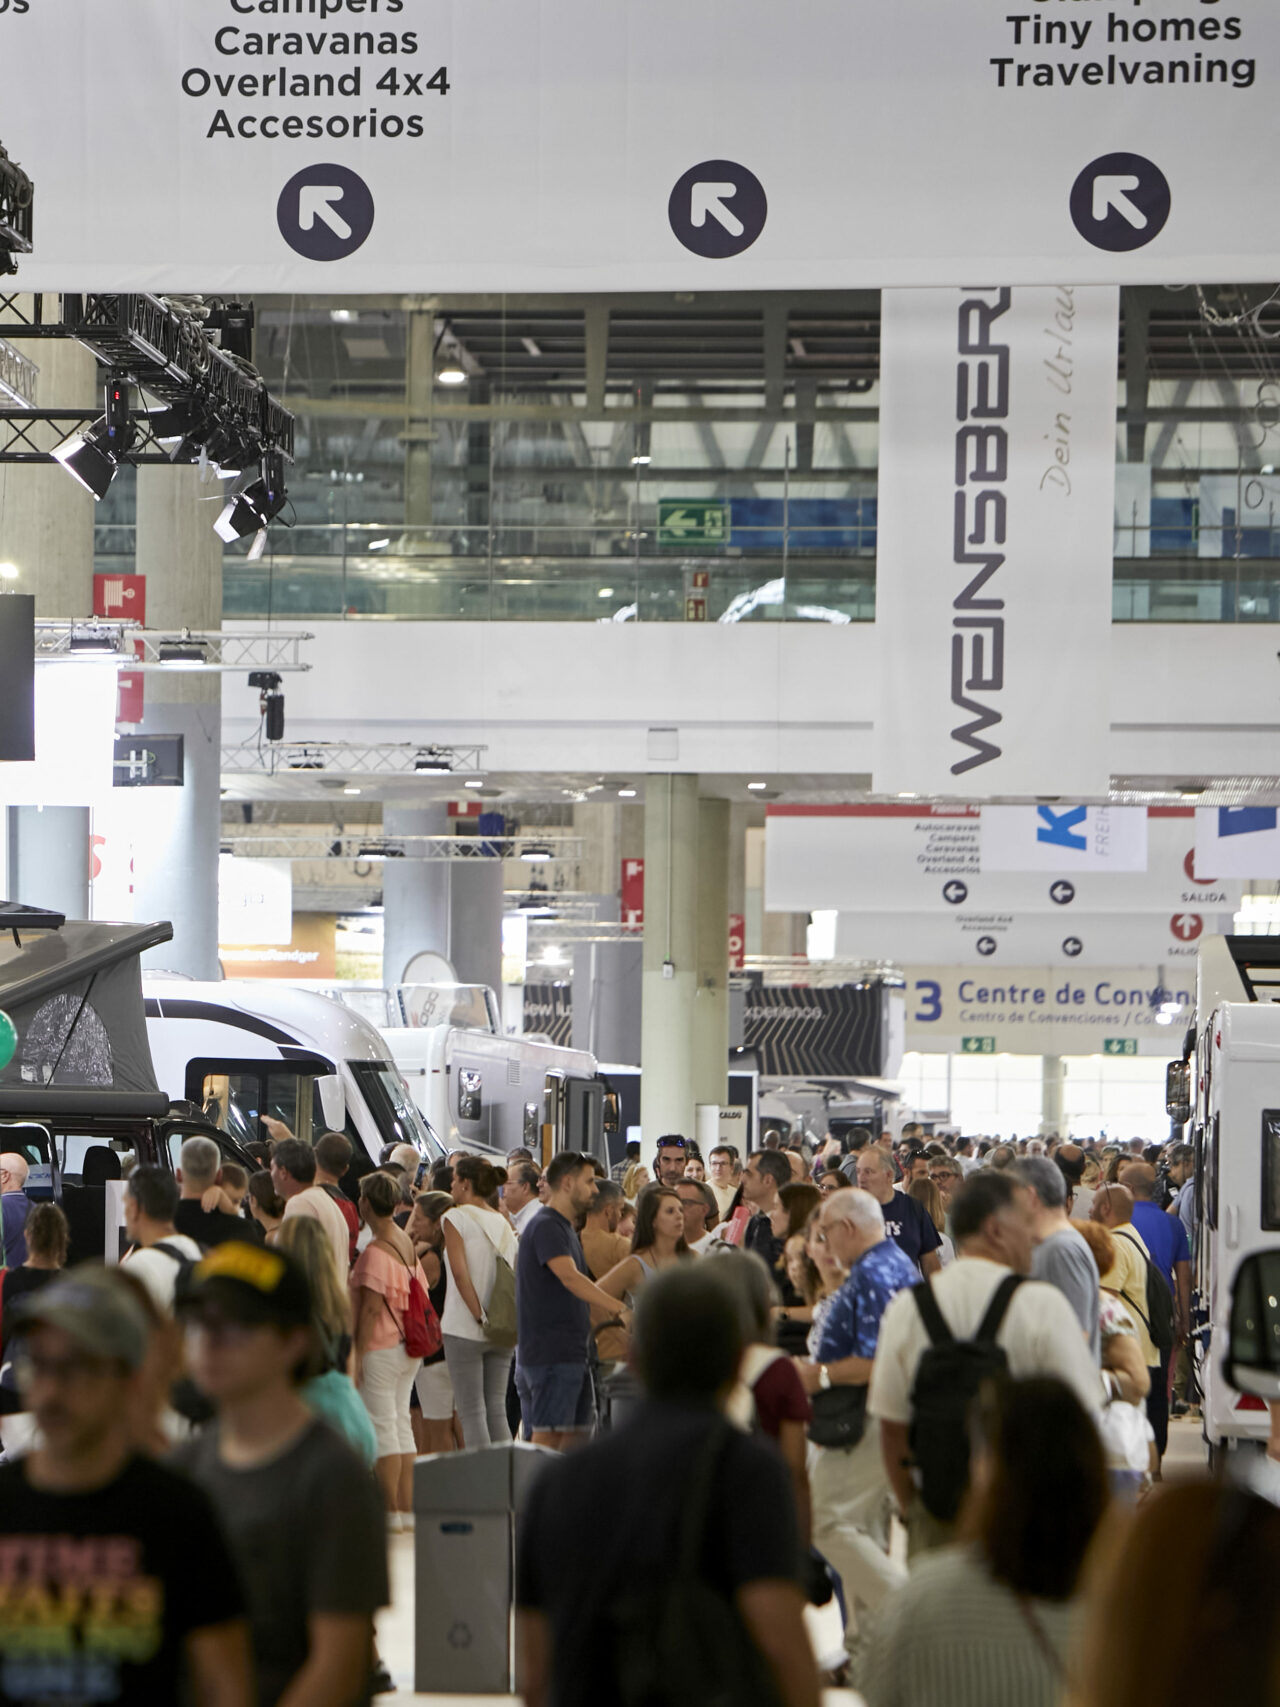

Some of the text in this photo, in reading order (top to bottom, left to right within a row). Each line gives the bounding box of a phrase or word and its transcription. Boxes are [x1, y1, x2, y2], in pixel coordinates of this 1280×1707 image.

[214, 26, 418, 55] Caravanas
[1006, 12, 1241, 50] Tiny homes
[181, 66, 451, 97] Overland 4x4
[989, 52, 1256, 88] Travelvaning
[206, 108, 424, 138] Accesorios
[1040, 412, 1072, 497] Dein
[950, 287, 1012, 775] WEINSBER
[1181, 892, 1227, 903] SALIDA
[958, 980, 1046, 1004] Centre
[1055, 982, 1086, 1004] de
[960, 1010, 1005, 1023] Centro
[1008, 1010, 1025, 1023] de
[1028, 1011, 1120, 1024] Convenciones
